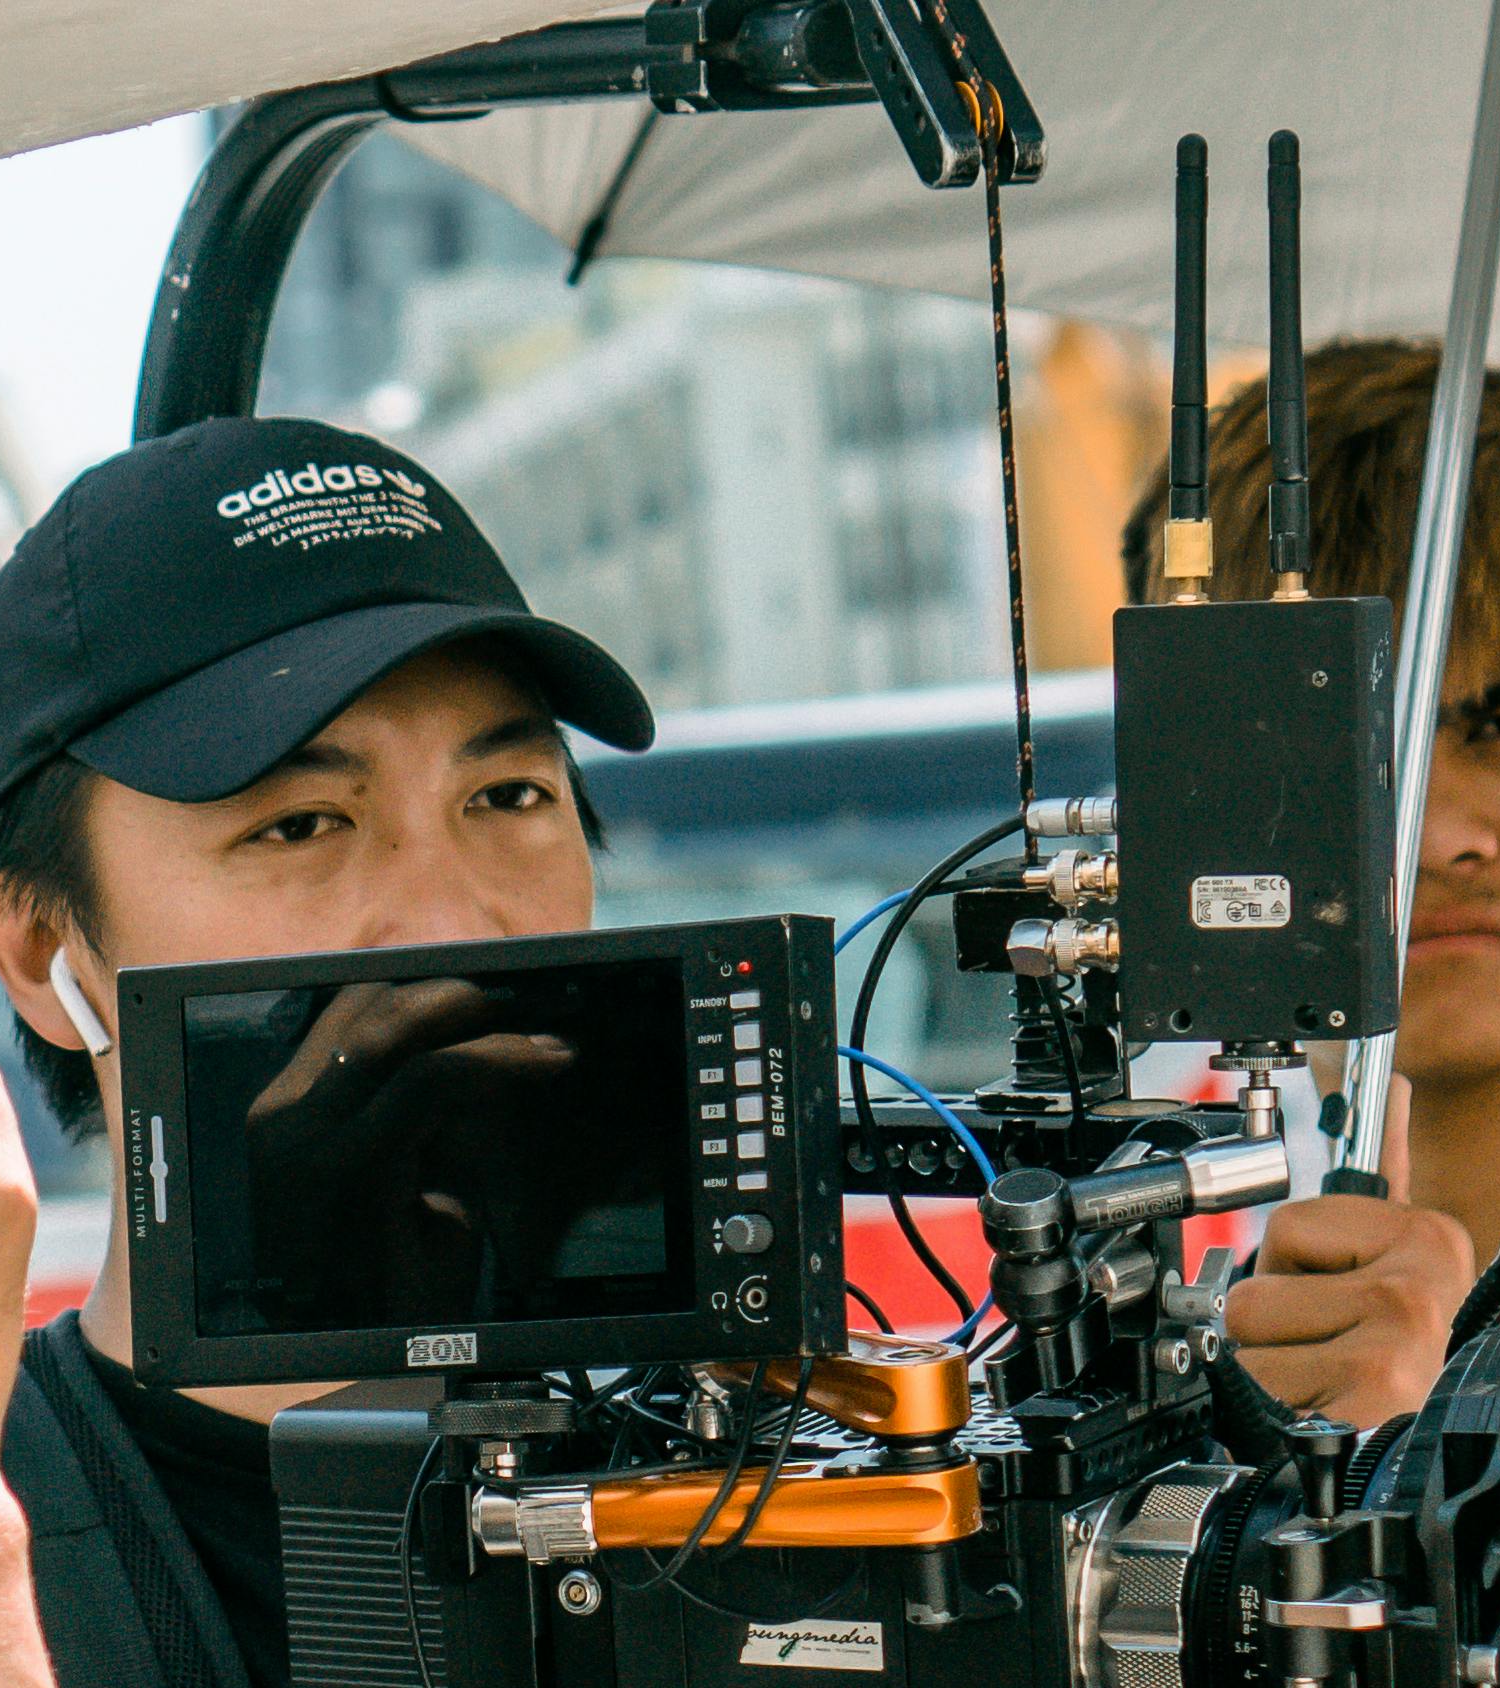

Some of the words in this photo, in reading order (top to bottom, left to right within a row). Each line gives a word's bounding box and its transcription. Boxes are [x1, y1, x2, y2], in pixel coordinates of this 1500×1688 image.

[217, 463, 382, 518] adidas
[690, 996, 728, 1009] STANDBY
[697, 1033, 723, 1045] INPUT
[707, 1070, 717, 1080] F1
[768, 1048, 786, 1137] BEM-072
[708, 1106, 718, 1116] F2
[709, 1141, 720, 1152] F3
[130, 1108, 147, 1238] MULTI-FORMAT
[703, 1177, 728, 1188] MENU
[748, 1625, 880, 1659] oungmedia
[1234, 1641, 1251, 1653] 5.6
[1244, 1668, 1252, 1680] 4
